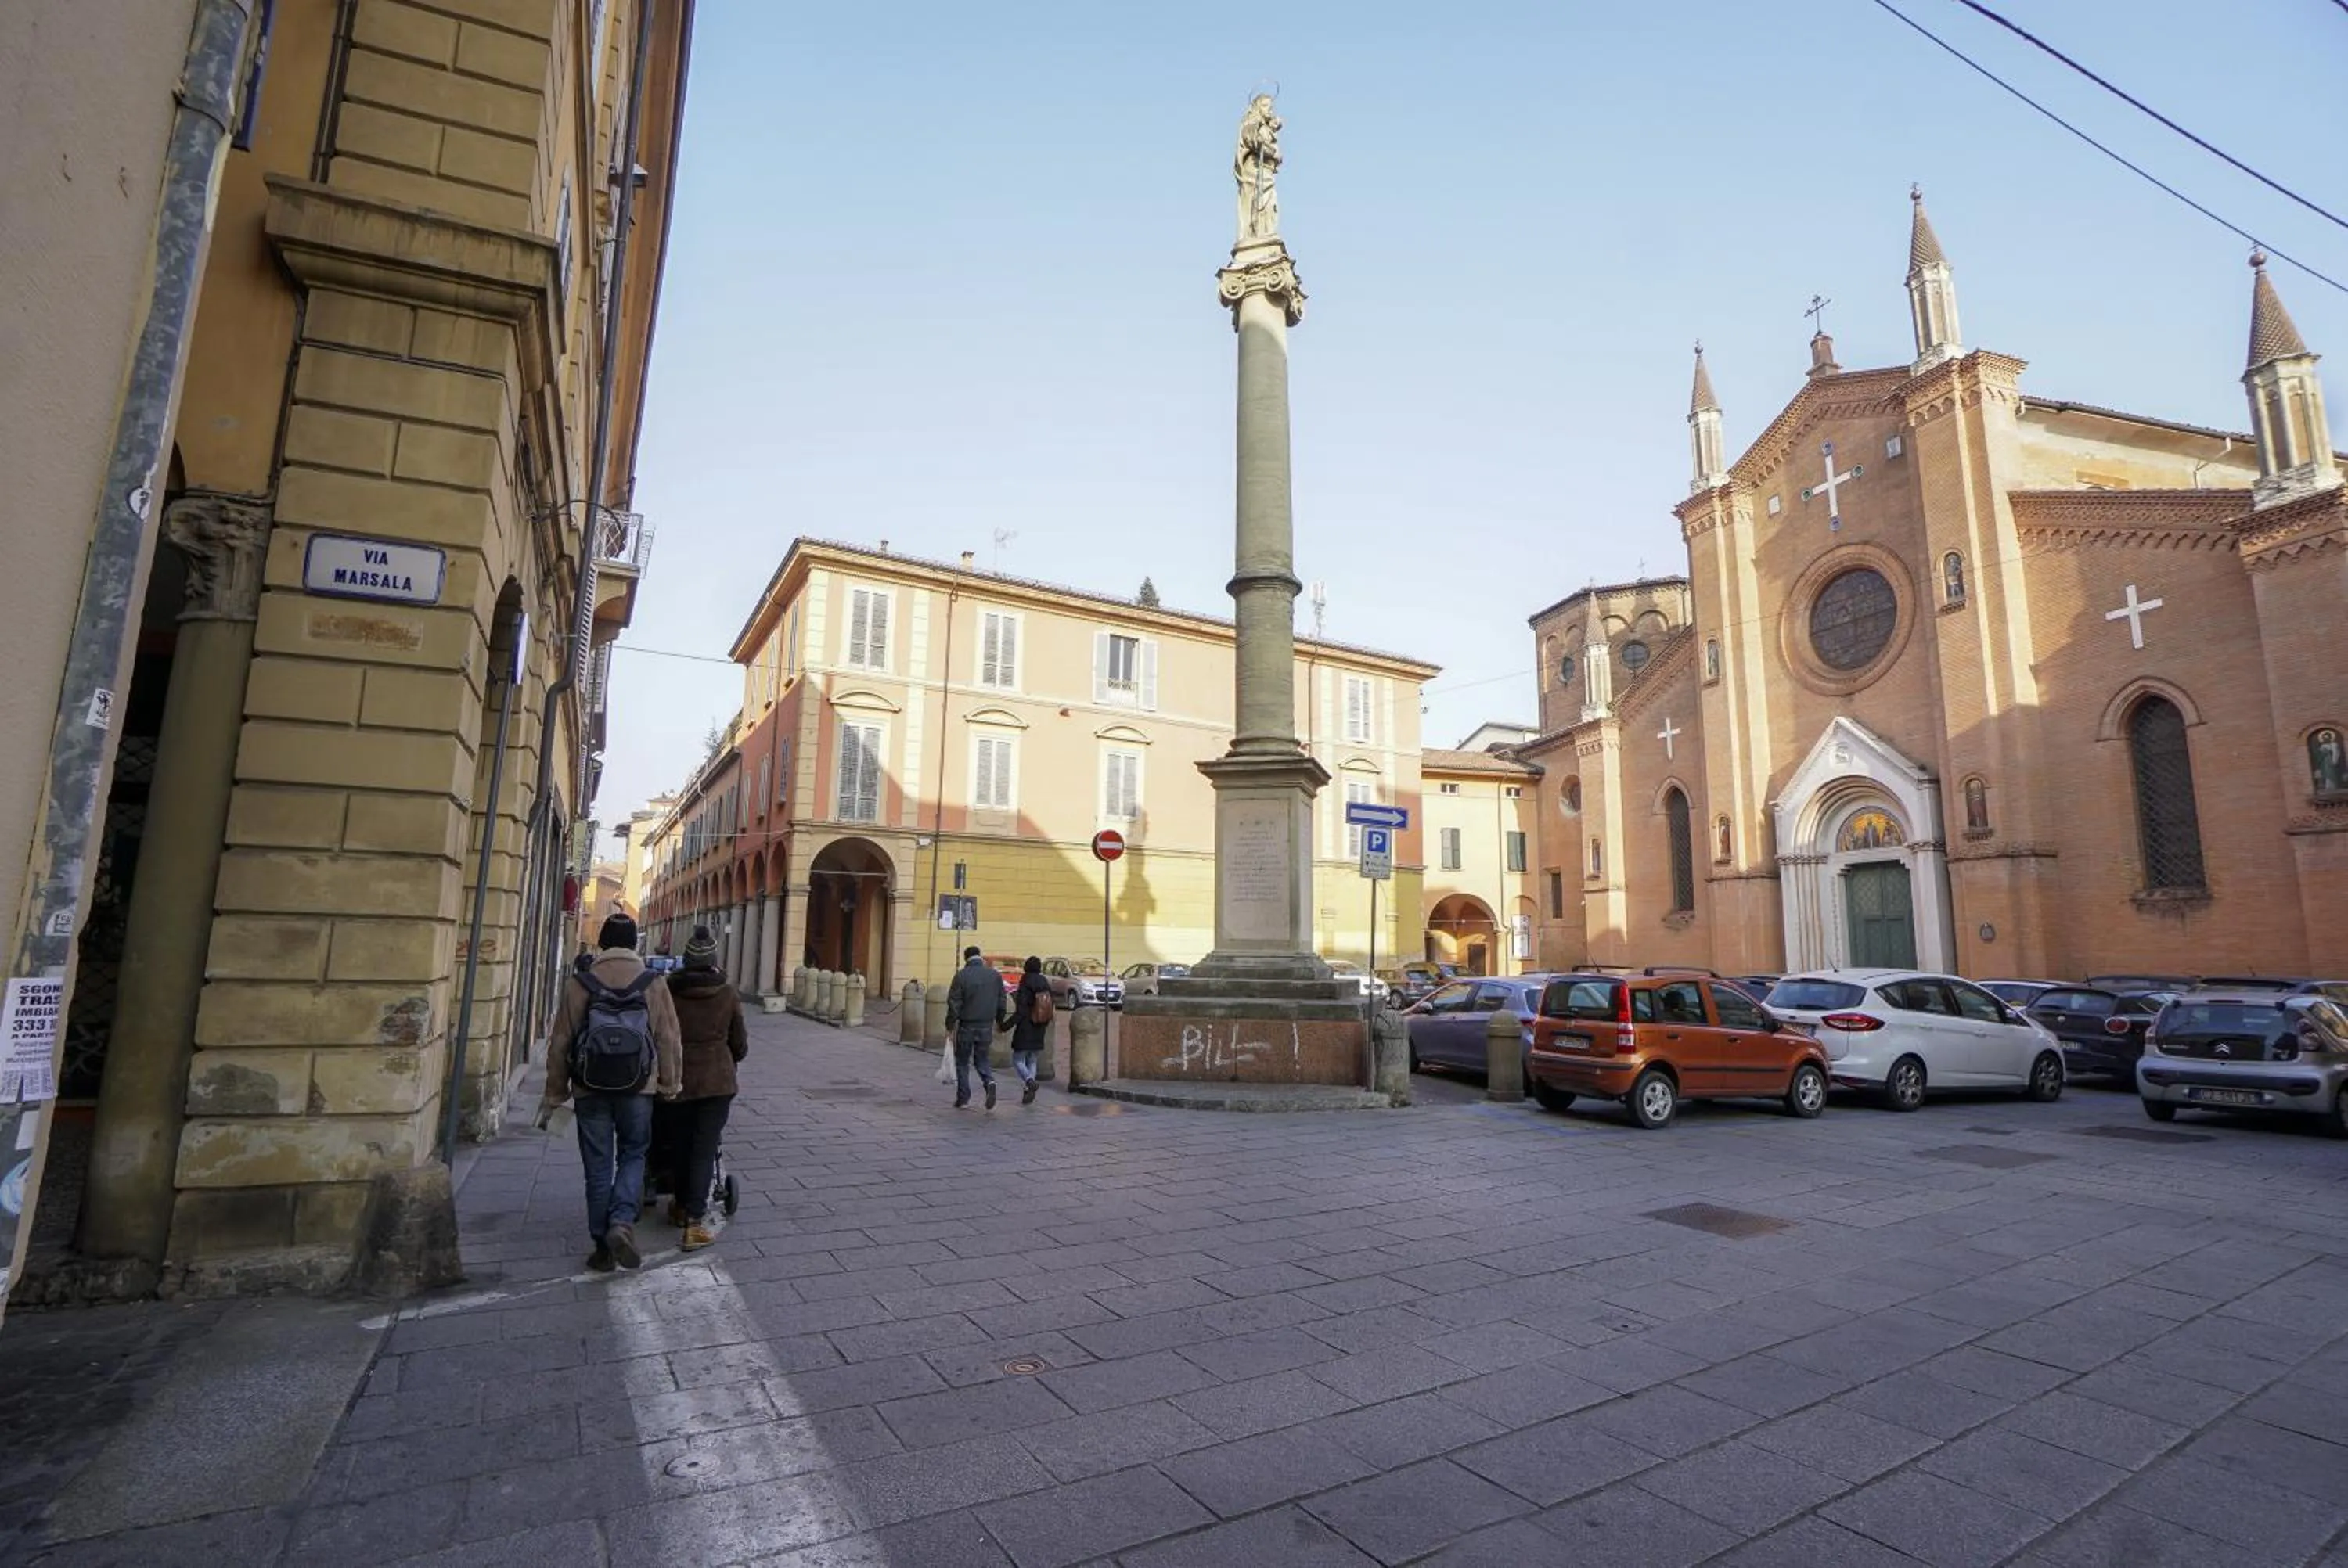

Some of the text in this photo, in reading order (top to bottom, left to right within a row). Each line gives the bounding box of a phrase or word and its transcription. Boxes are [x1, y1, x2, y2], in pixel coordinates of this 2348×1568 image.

[364, 549, 388, 565] VIA
[334, 569, 412, 592] MARSALA
[1371, 833, 1383, 849] P
